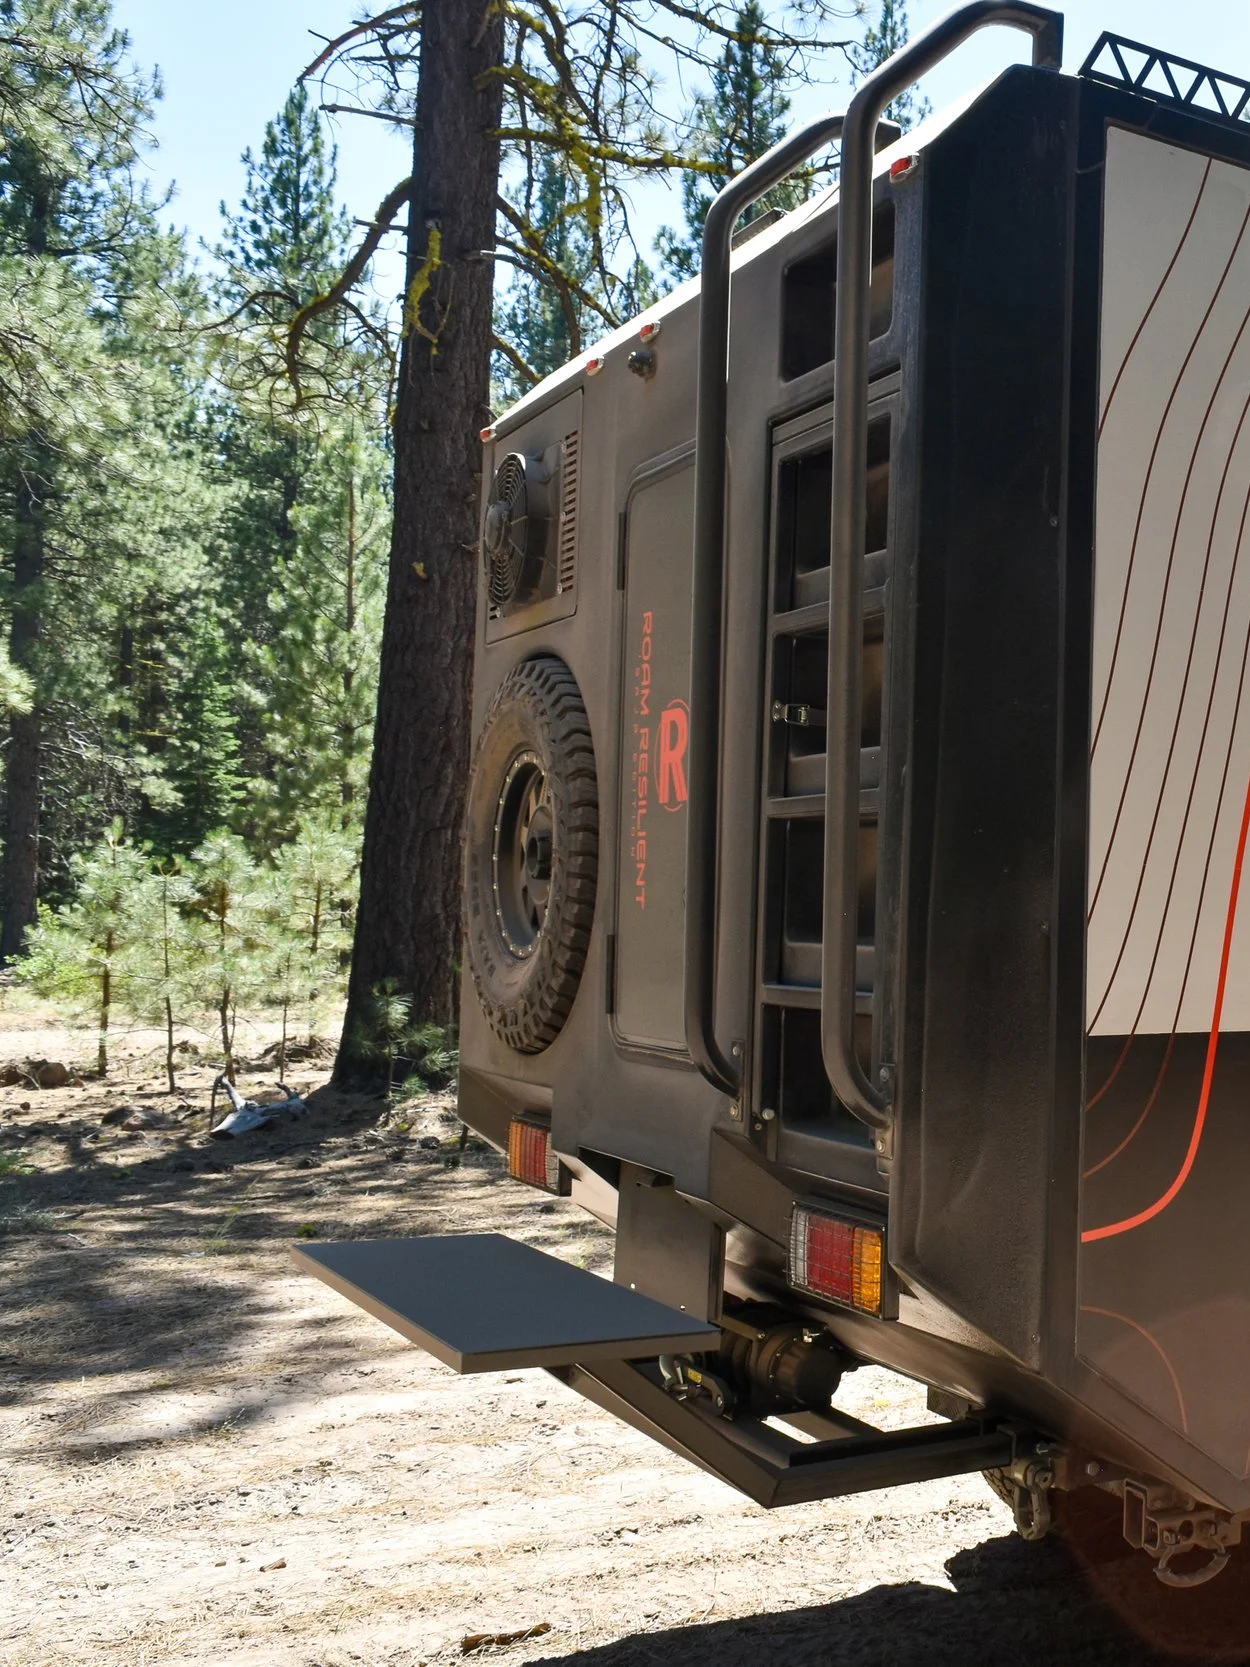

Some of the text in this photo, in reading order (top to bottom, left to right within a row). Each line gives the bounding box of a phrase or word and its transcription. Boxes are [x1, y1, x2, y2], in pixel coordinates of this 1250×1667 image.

[635, 611, 653, 909] ROAM RESILIENT
[658, 707, 689, 804] R
